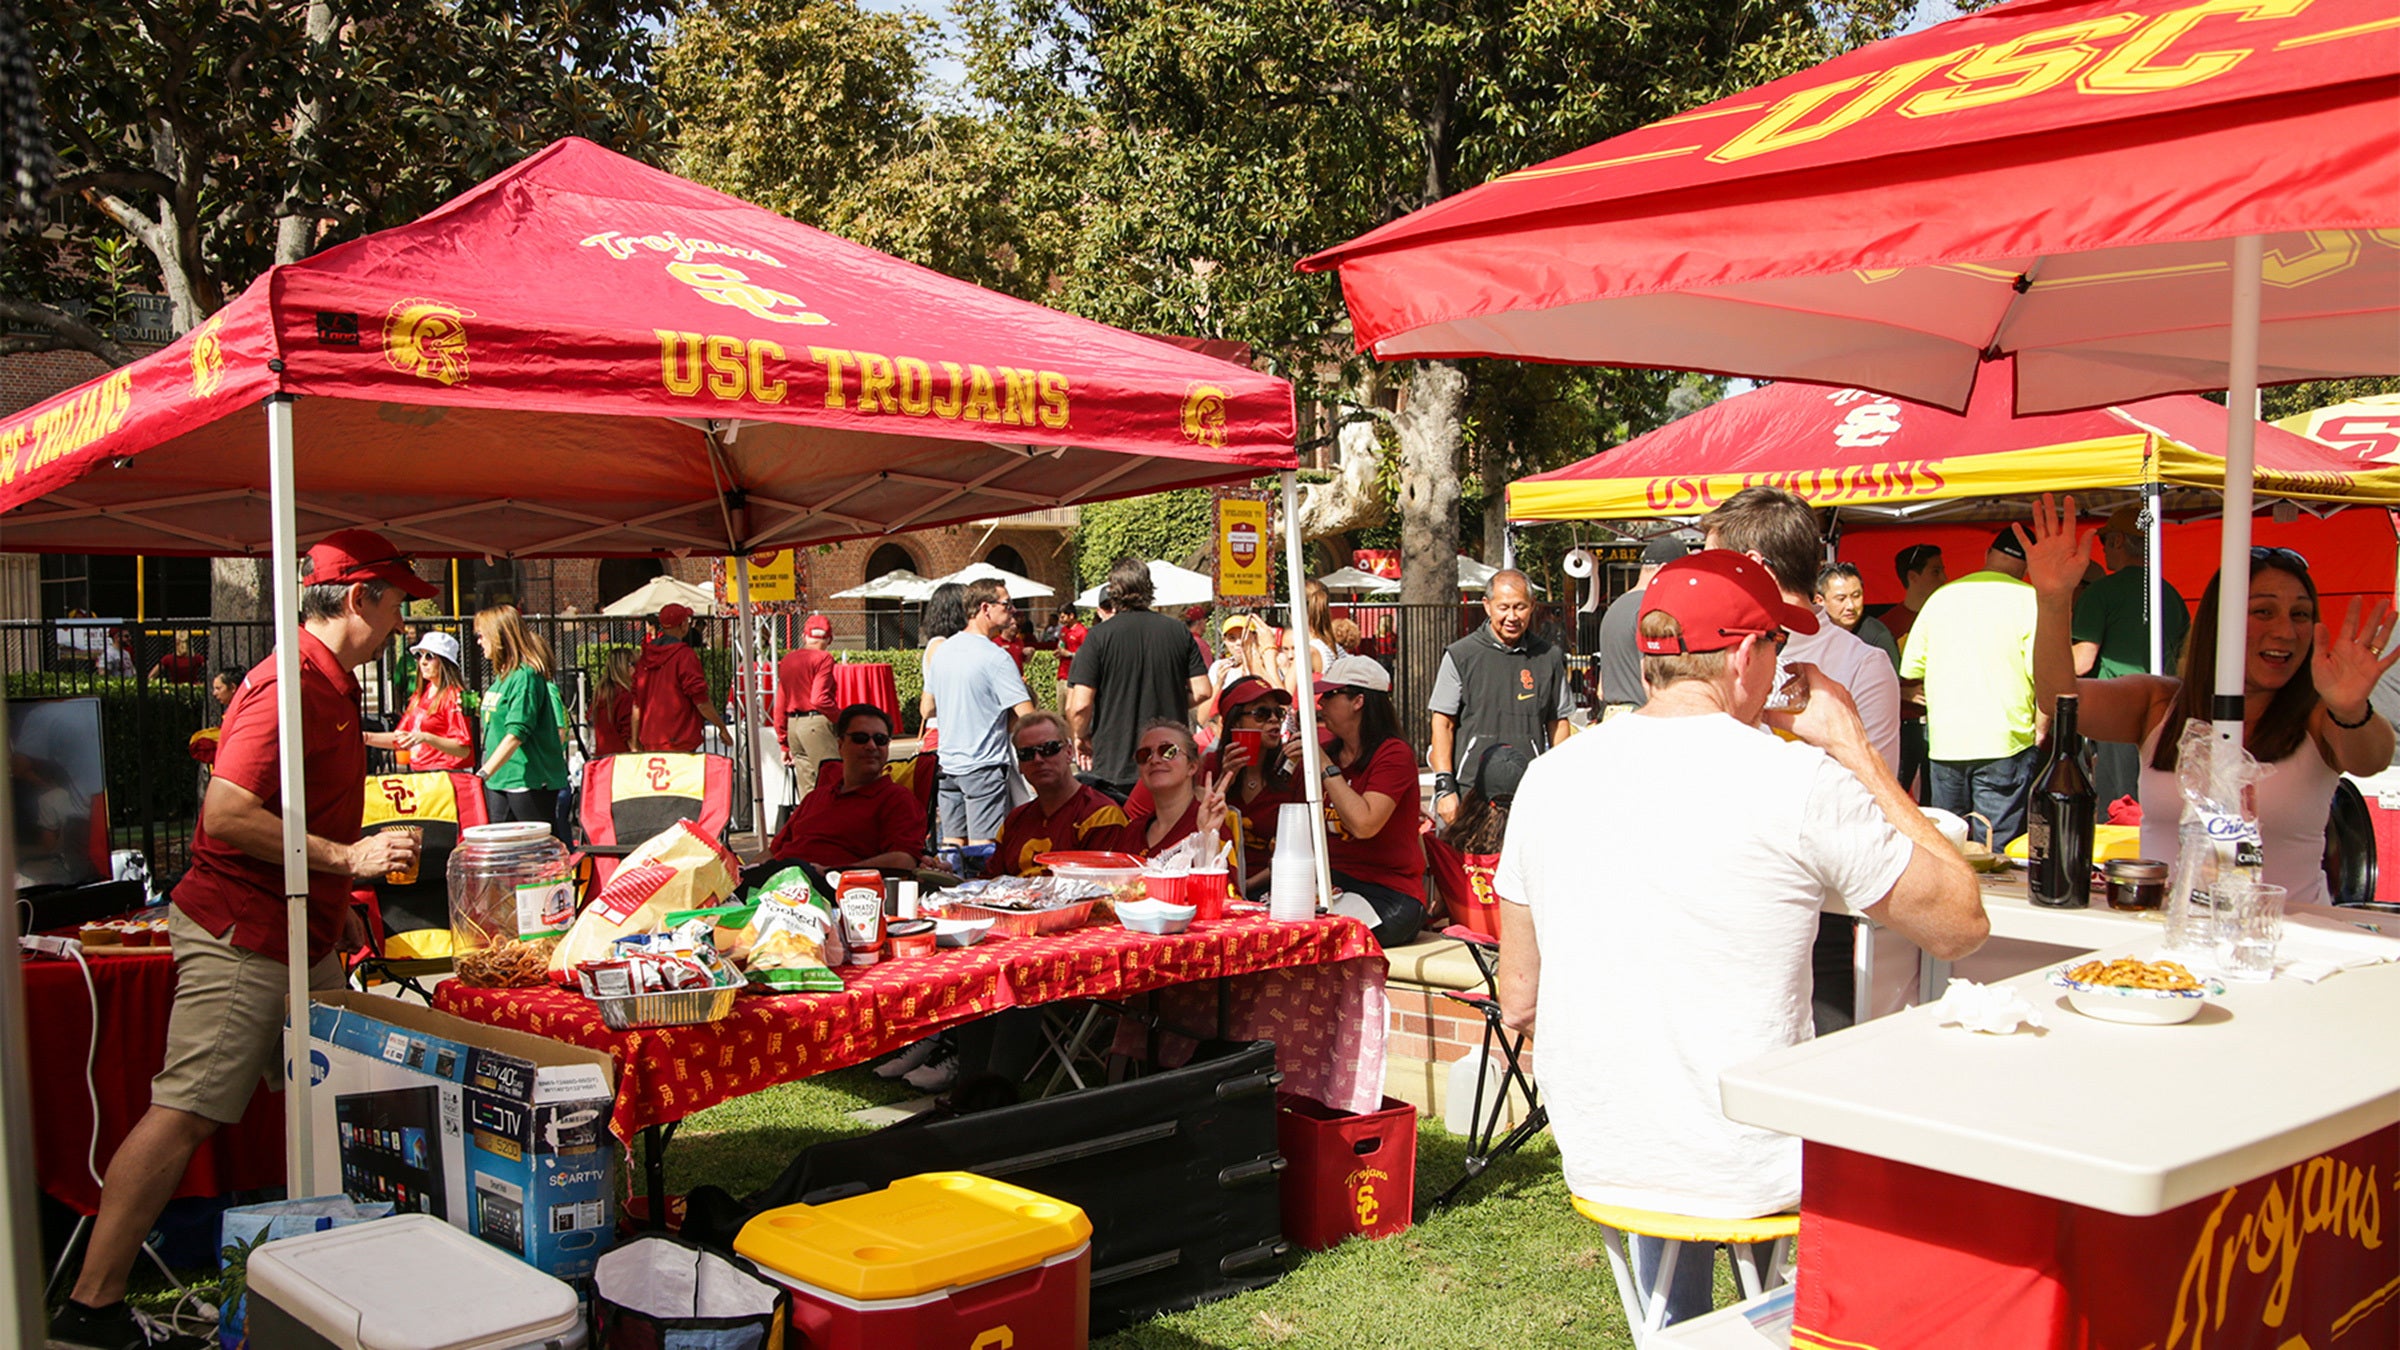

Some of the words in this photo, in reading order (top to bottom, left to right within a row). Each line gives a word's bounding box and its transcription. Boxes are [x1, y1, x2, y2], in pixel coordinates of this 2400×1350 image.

[1704, 0, 2309, 164] USC
[580, 231, 788, 268] Trojans
[653, 328, 788, 405] USC
[808, 344, 1072, 430] TROJANS
[24, 366, 133, 476] TROJANS
[1646, 478, 1724, 511] USC
[1610, 549, 1637, 560] ARE
[647, 757, 671, 791] SC
[382, 778, 418, 815] SC
[847, 903, 875, 911] TOMATO
[504, 1109, 522, 1136] TV
[496, 1138, 520, 1158] 5200
[1344, 1165, 1389, 1190] Trojans
[1356, 1185, 1379, 1226] SC
[2165, 1156, 2383, 1350] Trojans
